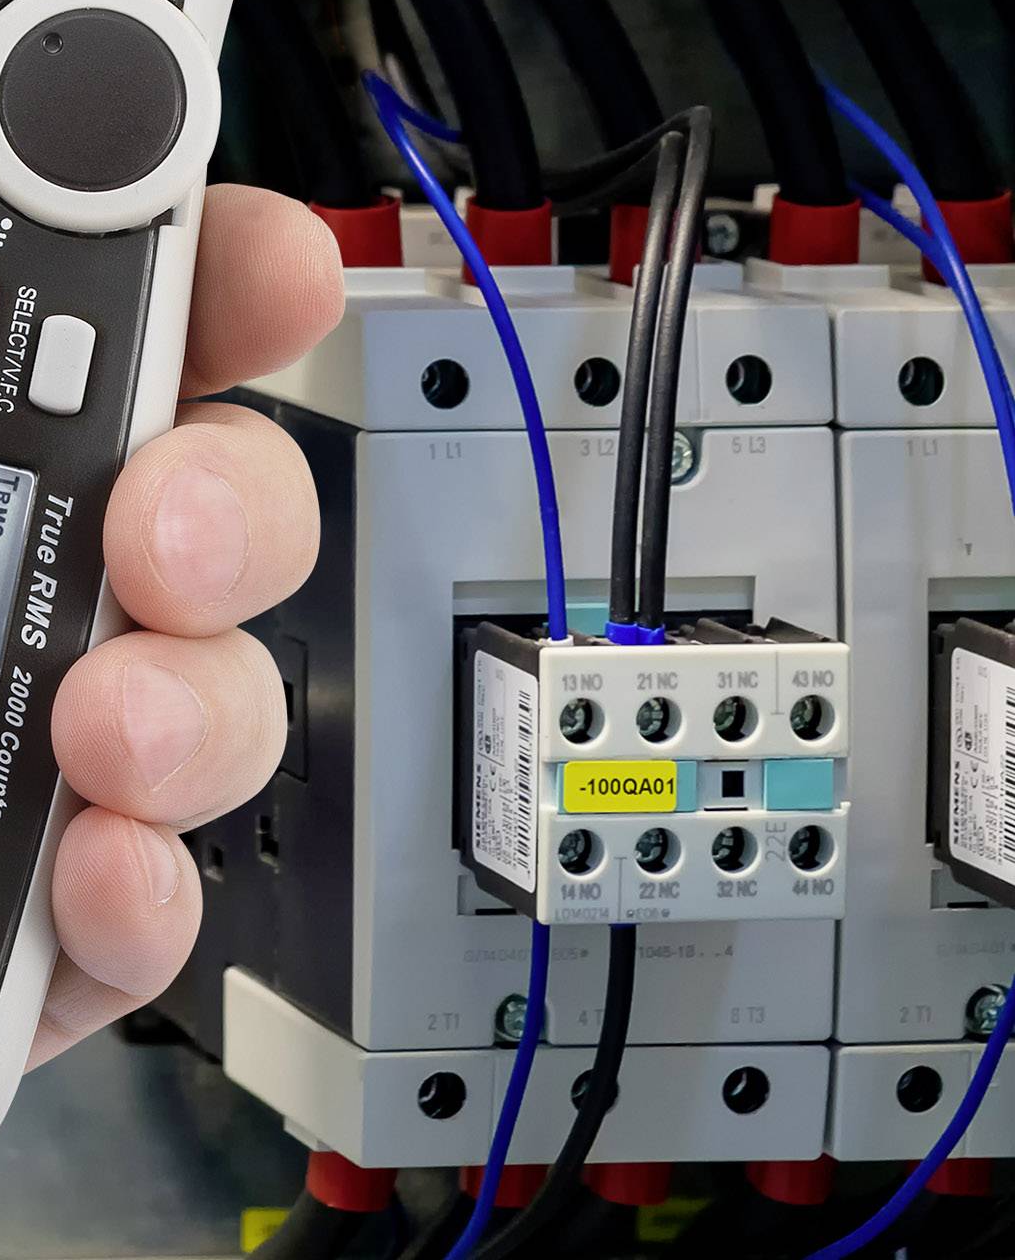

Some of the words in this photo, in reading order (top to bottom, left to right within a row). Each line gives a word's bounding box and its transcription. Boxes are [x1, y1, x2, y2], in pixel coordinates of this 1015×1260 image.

[446, 443, 463, 459] L1
[598, 439, 615, 456] L2
[749, 437, 767, 453] L3
[922, 440, 938, 456] L1
[37, 493, 74, 565] True
[20, 568, 59, 651] RMS
[562, 674, 578, 691] 13
[581, 674, 603, 691] NO
[637, 673, 653, 690] 21
[656, 672, 678, 689] NC
[717, 672, 733, 689] 31
[737, 671, 758, 688] NC
[792, 671, 809, 688] 43
[812, 670, 834, 687] NO
[2, 666, 34, 728] 2000
[579, 777, 675, 796] -100QA01
[475, 763, 483, 849] SIEMENS
[953, 760, 961, 845] SIEMENS
[765, 821, 786, 862] 22E
[561, 884, 577, 900] 14
[580, 883, 601, 899] NO
[639, 882, 656, 899] 22
[659, 881, 680, 898] NC
[717, 881, 733, 898] 32
[736, 880, 757, 897] NC
[792, 879, 809, 896] 44
[812, 878, 834, 895] NO
[428, 1014, 437, 1031] 2
[443, 1013, 459, 1030] T1
[579, 1011, 588, 1027] 4
[594, 1010, 605, 1025] T
[747, 1006, 765, 1023] T3
[899, 1007, 909, 1023] 2
[915, 1005, 931, 1022] T1
